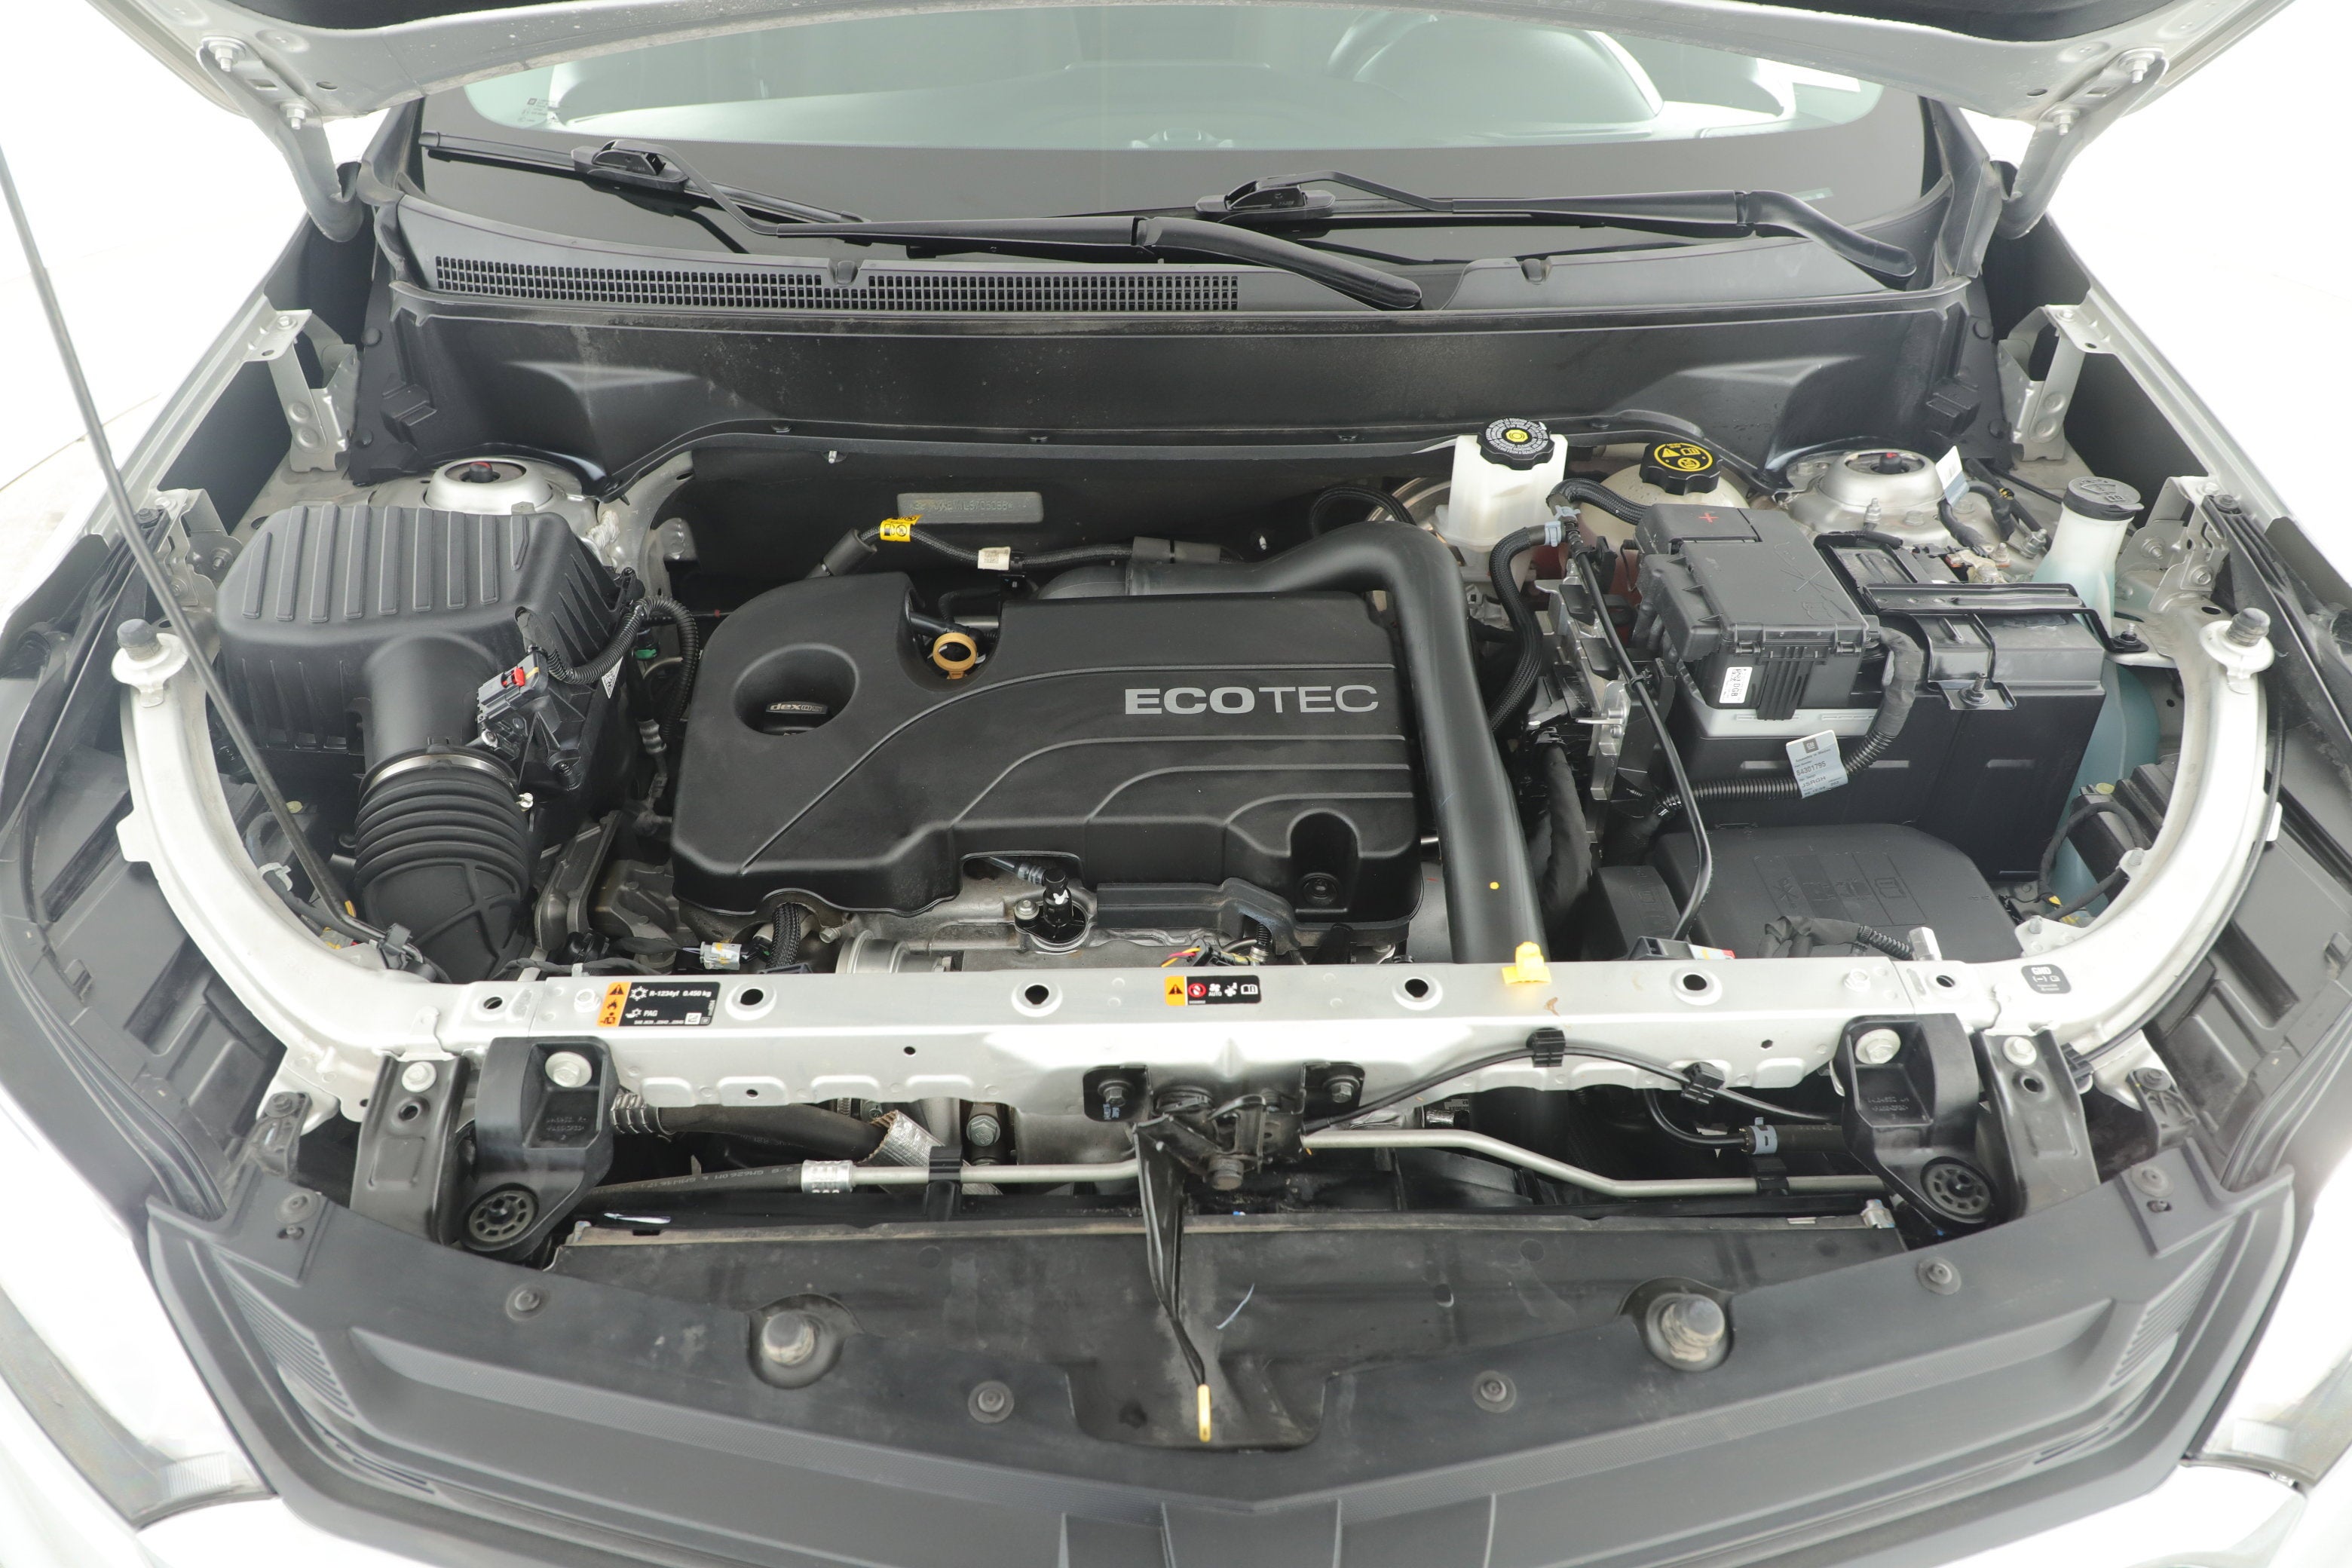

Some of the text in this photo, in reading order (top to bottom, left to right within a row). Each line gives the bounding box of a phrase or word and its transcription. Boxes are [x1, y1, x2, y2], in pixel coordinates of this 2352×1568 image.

[1125, 684, 1379, 715] ECOTEC
[770, 703, 822, 712] dexos
[1796, 761, 1827, 776] 84301795
[1802, 776, 1827, 788] JSRGH
